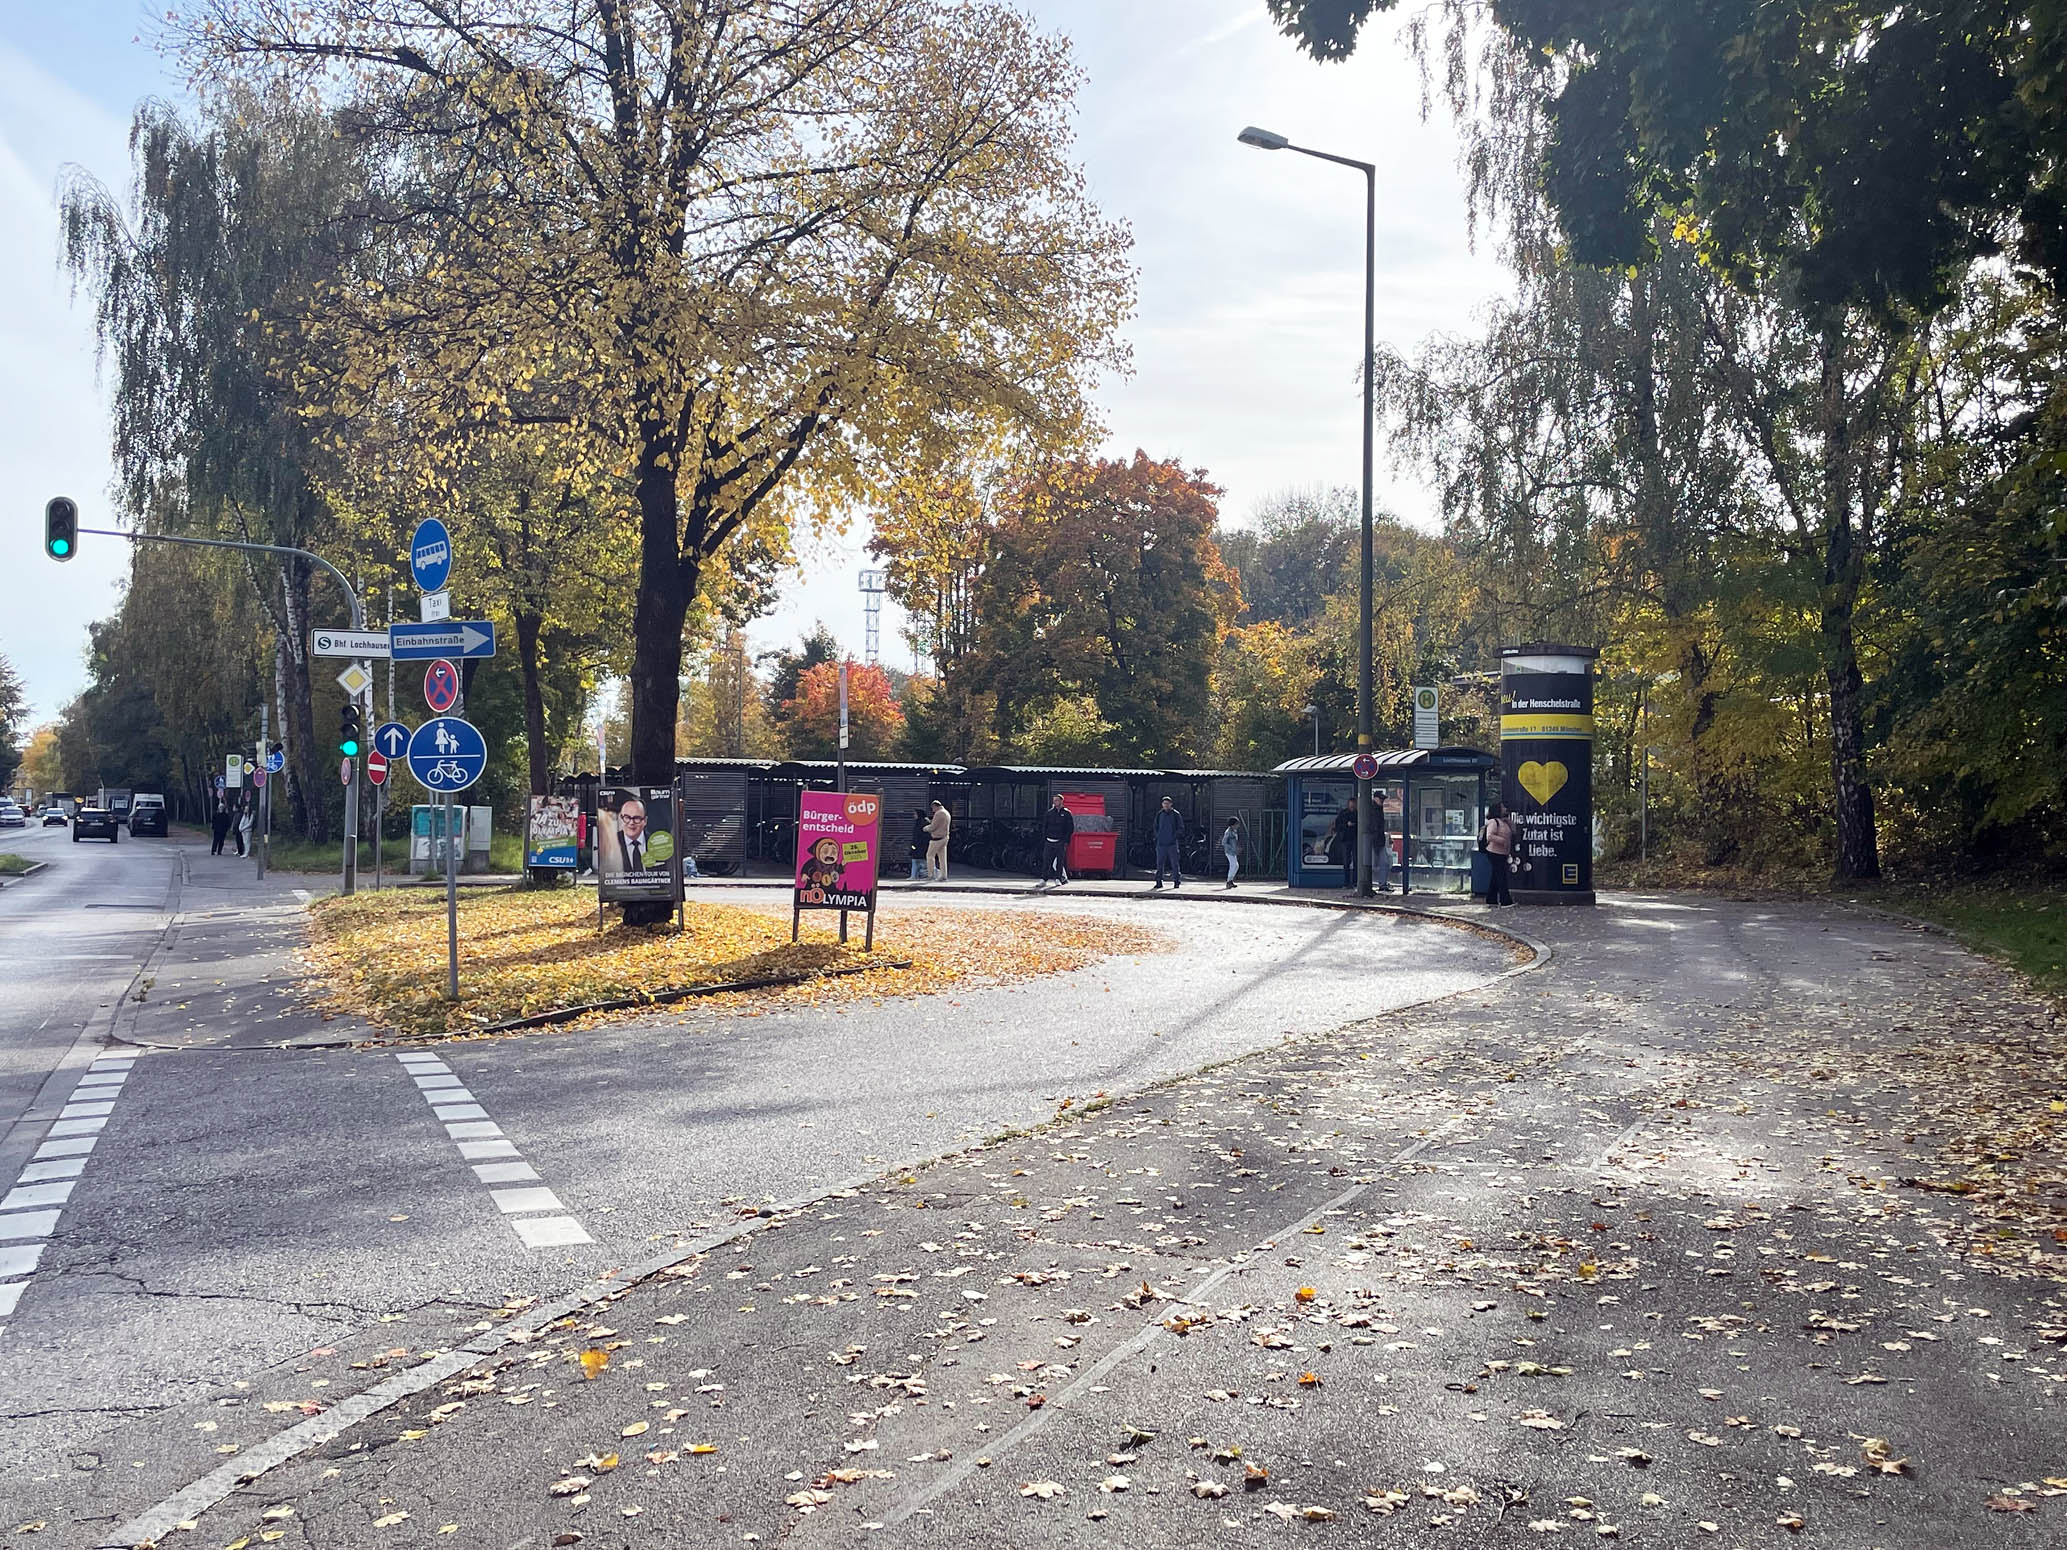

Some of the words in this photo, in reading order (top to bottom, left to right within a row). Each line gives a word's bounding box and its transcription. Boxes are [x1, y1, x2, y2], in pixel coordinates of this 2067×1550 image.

[429, 597, 442, 608] Taxi
[396, 637, 464, 647] Einbahnstraße
[1518, 699, 1528, 708] der
[1529, 698, 1581, 709] Henschelstraße
[848, 800, 876, 815] ödp
[803, 811, 843, 823] Bürger-
[1511, 812, 1524, 825] Die
[1525, 812, 1577, 828] wichtigste
[802, 823, 854, 834] entscheid
[1522, 828, 1548, 841] Zutat
[1550, 828, 1564, 841] ist
[1528, 844, 1557, 857] Liebe.
[548, 856, 566, 864] CSU
